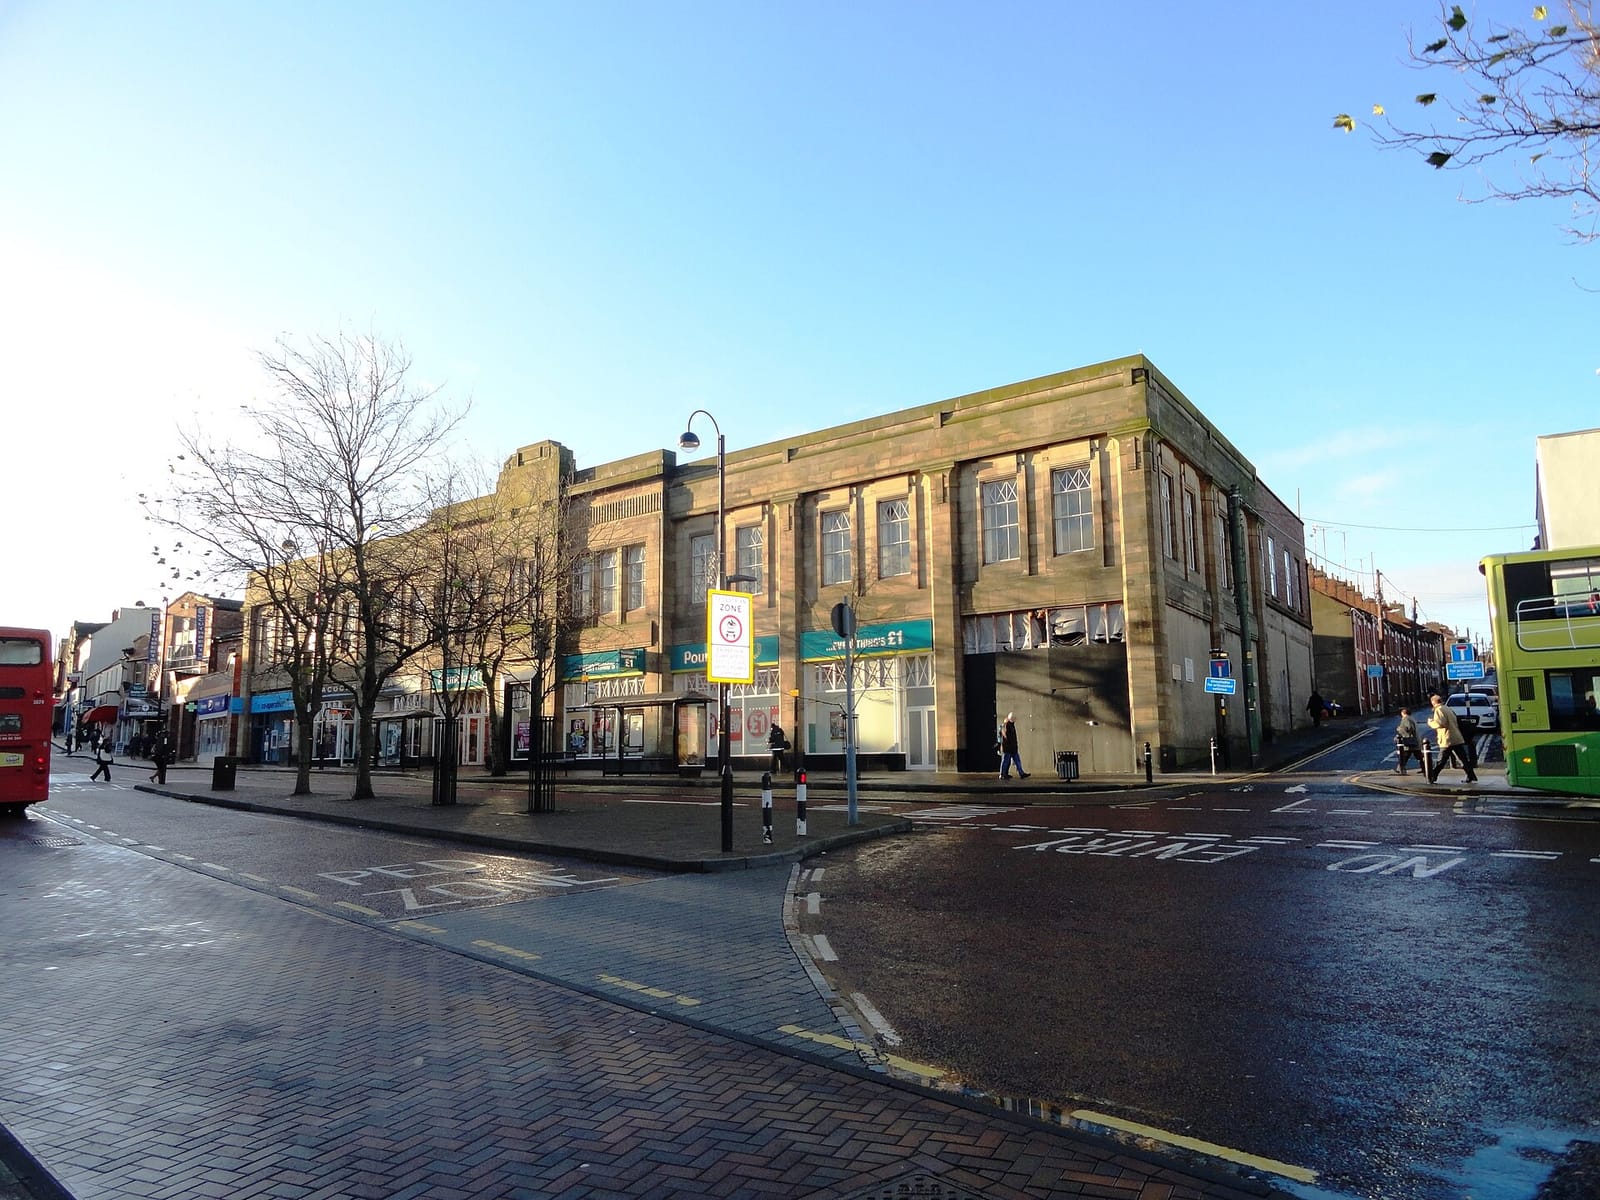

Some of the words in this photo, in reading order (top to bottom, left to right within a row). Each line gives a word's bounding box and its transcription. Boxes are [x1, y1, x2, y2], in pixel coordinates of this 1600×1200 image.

[719, 603, 743, 613] ZONE
[887, 629, 903, 645] £1
[1012, 836, 1260, 863] ENTRY
[315, 859, 487, 886] PED
[1326, 854, 1467, 878] NO
[361, 867, 620, 911] ZONE
